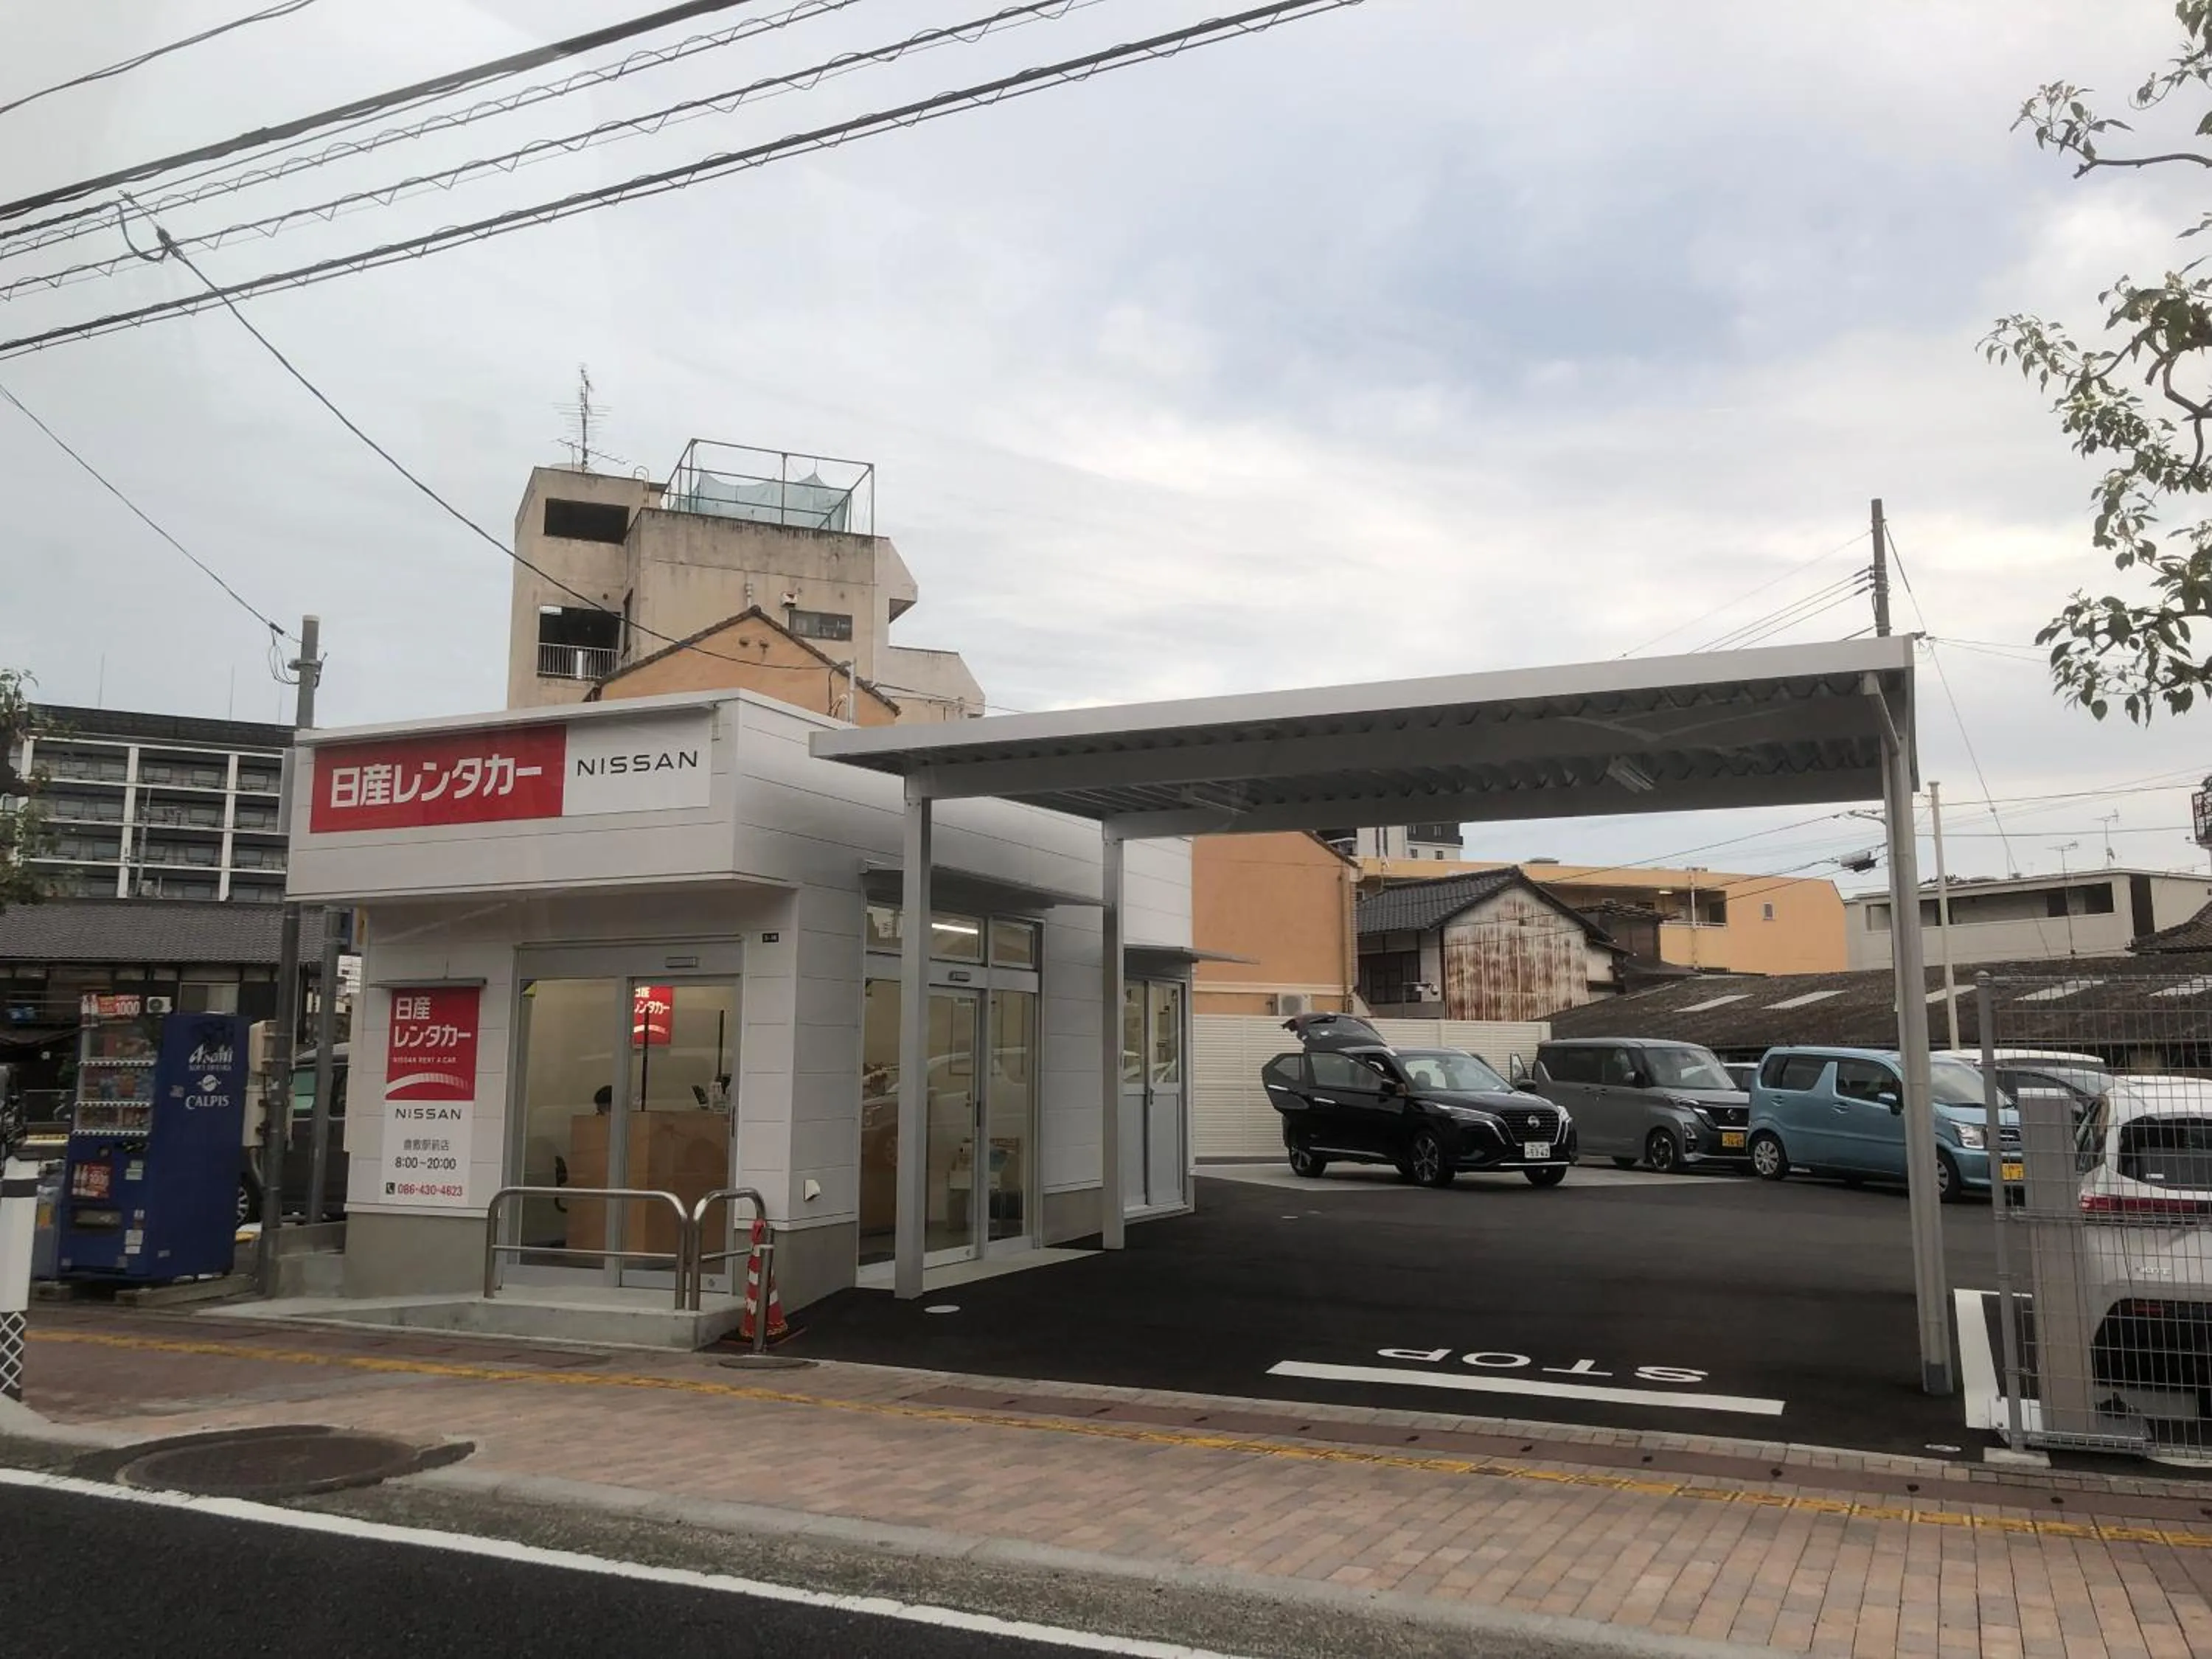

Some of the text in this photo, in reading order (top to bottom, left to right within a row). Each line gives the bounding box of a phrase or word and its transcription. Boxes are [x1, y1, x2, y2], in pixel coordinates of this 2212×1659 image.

[577, 751, 698, 776] NISSAN
[330, 754, 542, 808] 日産レンタカー
[395, 996, 431, 1020] 日産
[394, 1024, 471, 1048] レンタカー
[189, 1044, 233, 1063] Asahi
[186, 1096, 230, 1110] CALPIS
[394, 1107, 462, 1120] NISSAN
[1377, 1347, 1708, 1382] STOP
